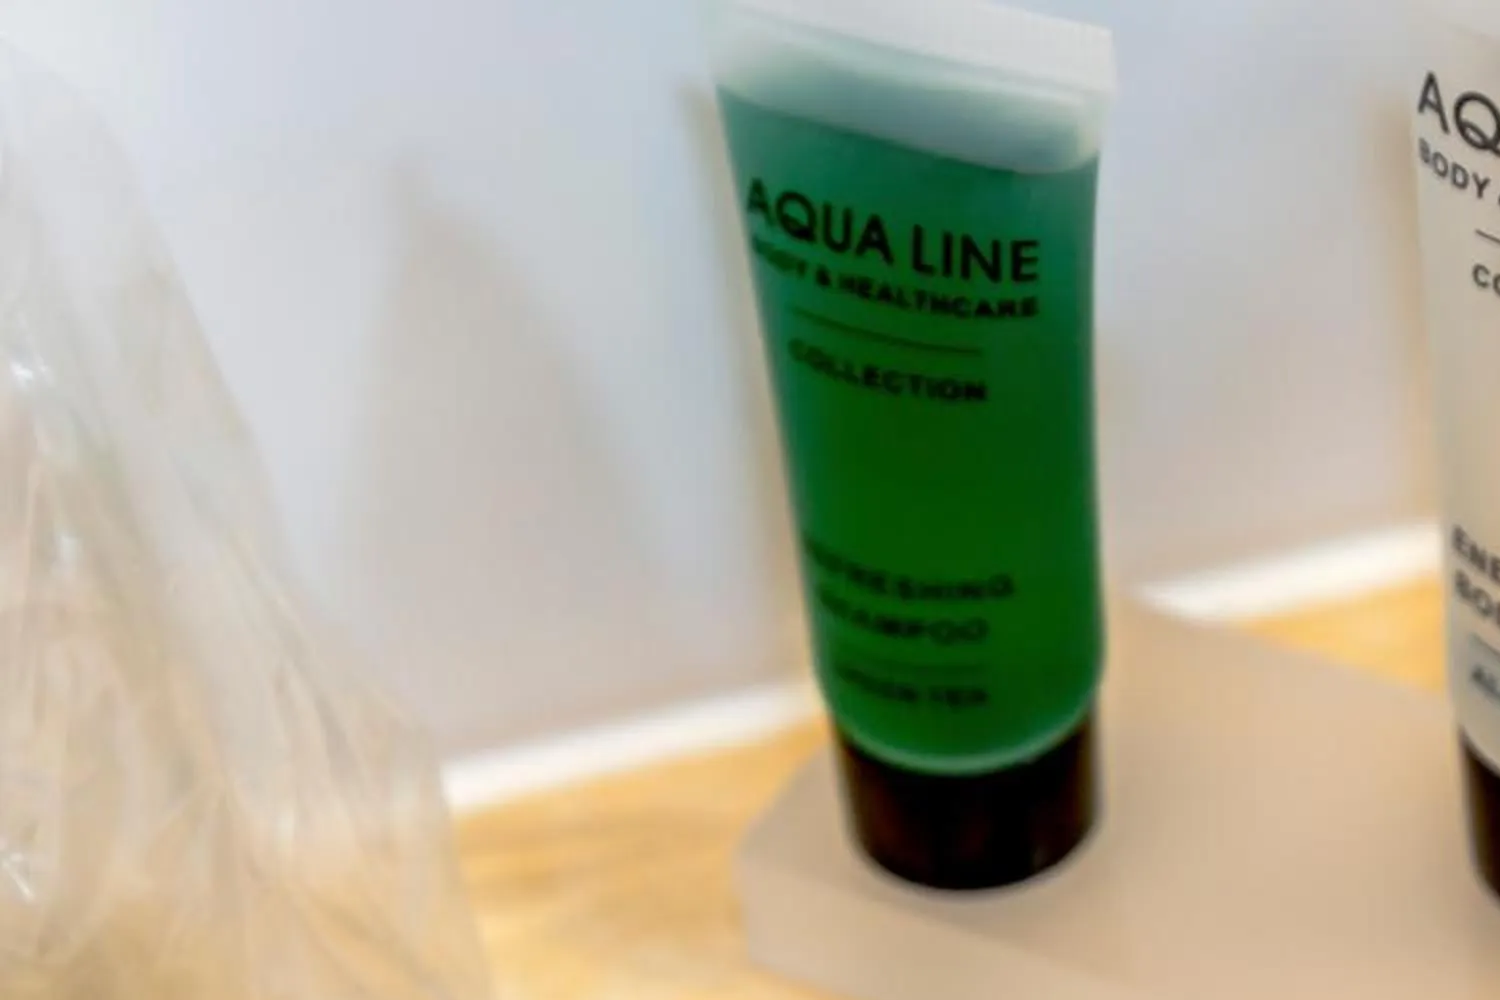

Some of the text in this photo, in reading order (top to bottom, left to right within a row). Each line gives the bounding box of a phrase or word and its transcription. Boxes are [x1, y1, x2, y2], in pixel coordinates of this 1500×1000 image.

[1418, 137, 1490, 200] BODY
[747, 177, 1039, 284] AQUA LINE
